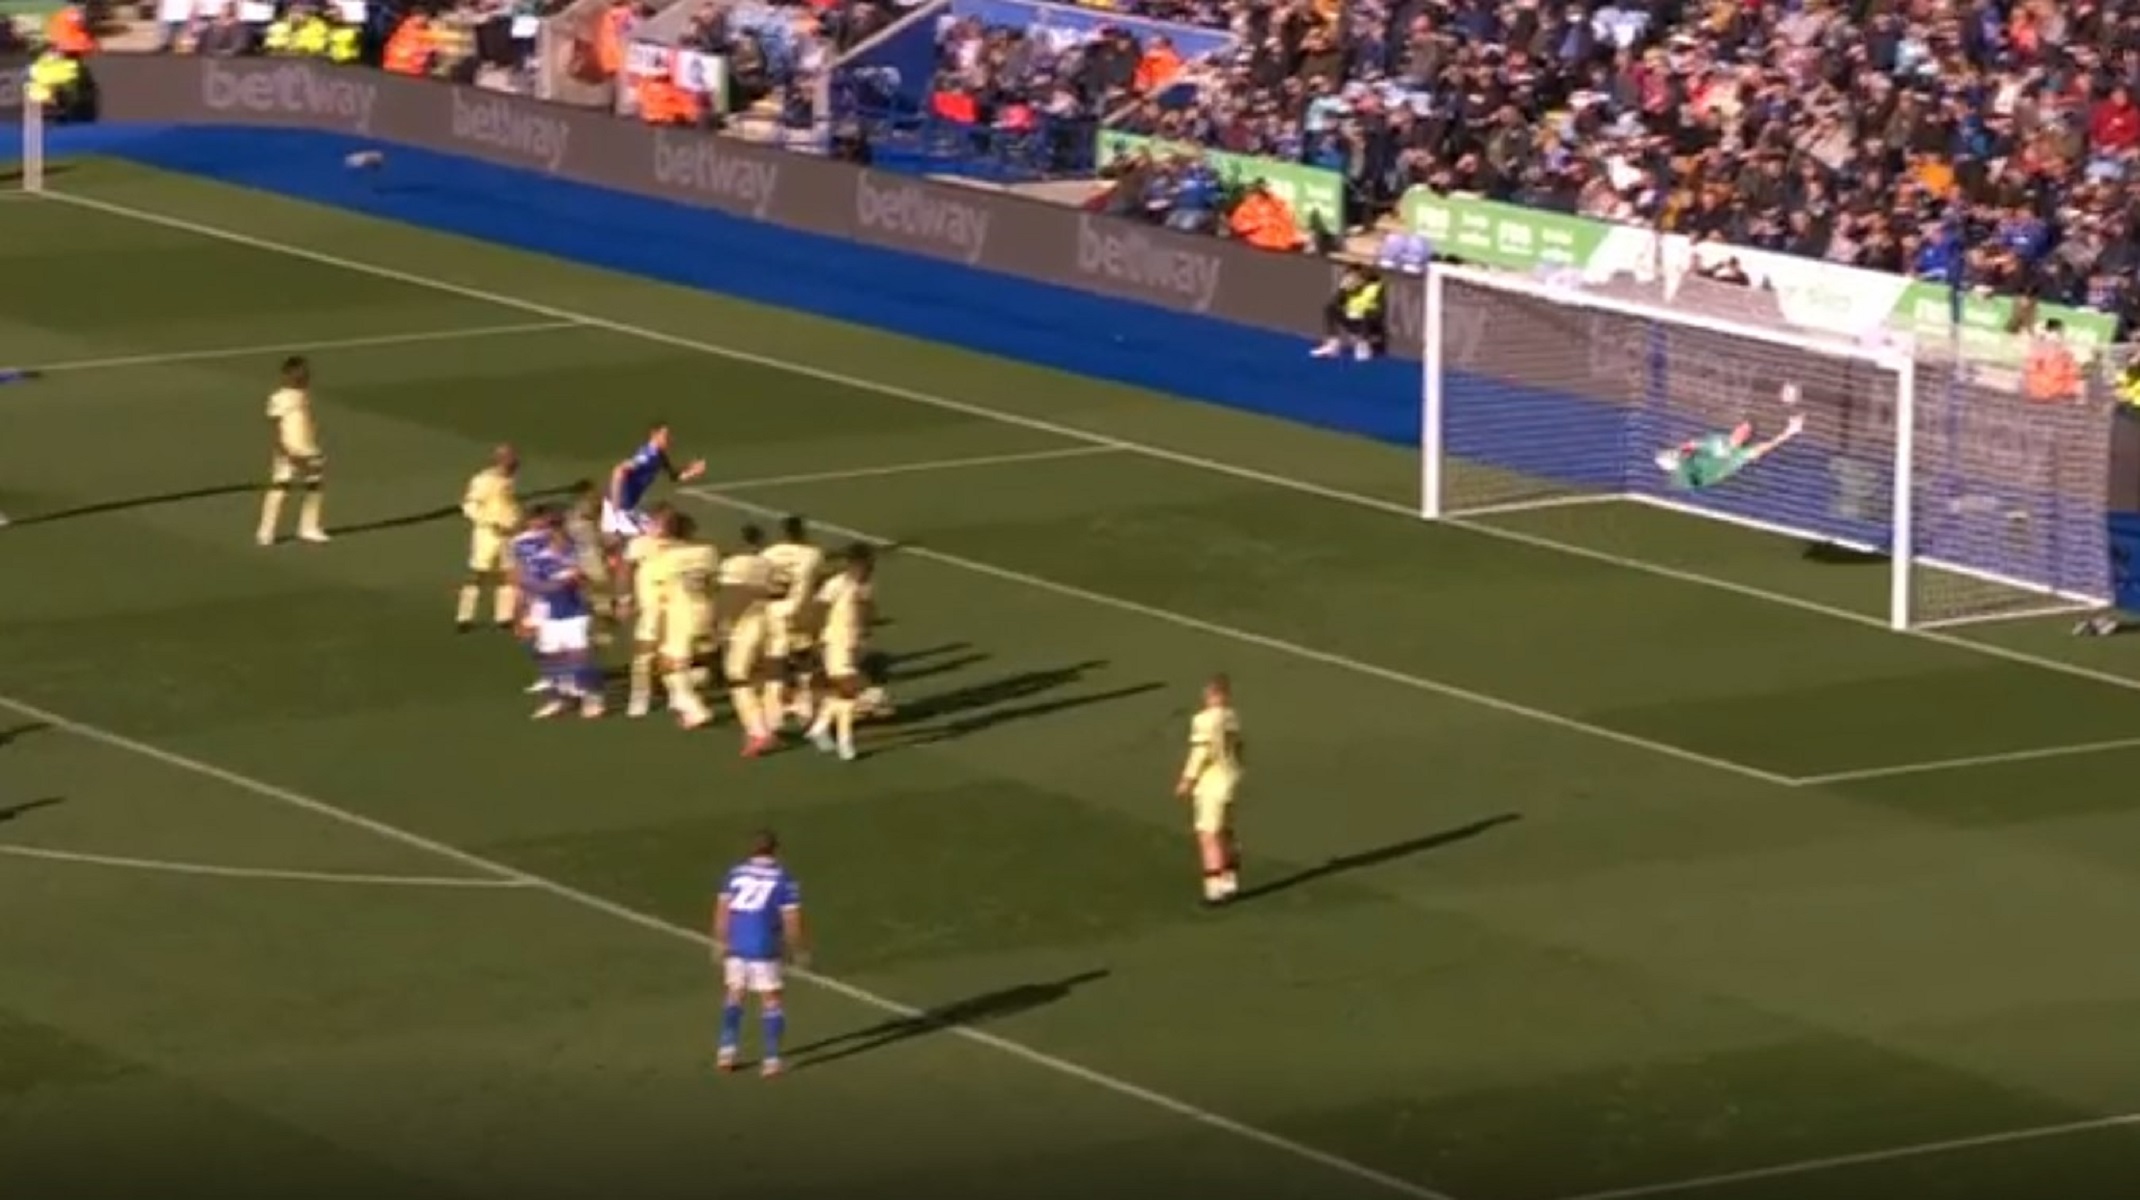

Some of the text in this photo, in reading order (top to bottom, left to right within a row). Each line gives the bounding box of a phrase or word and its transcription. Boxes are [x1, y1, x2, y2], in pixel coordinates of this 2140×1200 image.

[204, 58, 376, 132] betway
[452, 86, 569, 174] betway
[654, 133, 778, 219] betway
[856, 169, 989, 264] betway
[1078, 213, 1221, 313] betway
